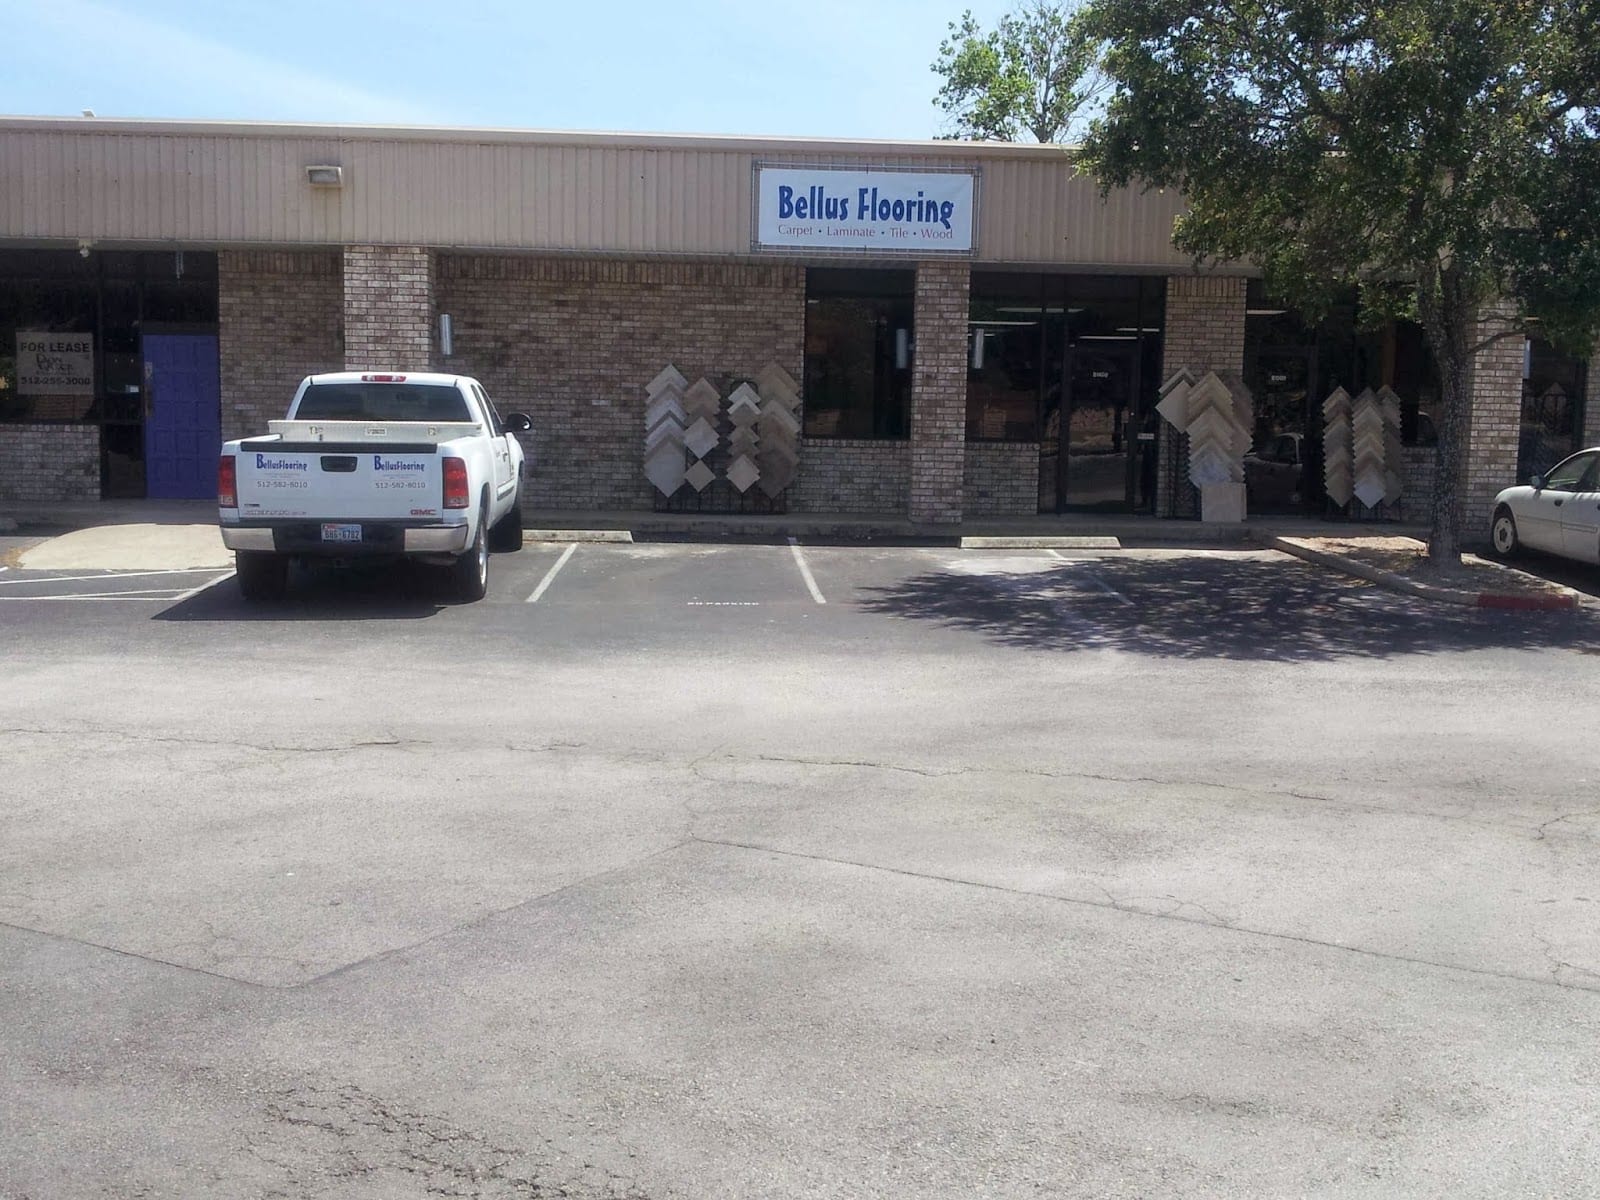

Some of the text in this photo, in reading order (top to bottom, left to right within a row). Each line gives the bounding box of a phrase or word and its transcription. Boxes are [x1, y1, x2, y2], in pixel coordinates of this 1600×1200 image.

[778, 185, 954, 230] Bellus Flooring
[778, 224, 953, 239] Carpet Laminate Tile Wood
[20, 342, 91, 353] FOR LEASE
